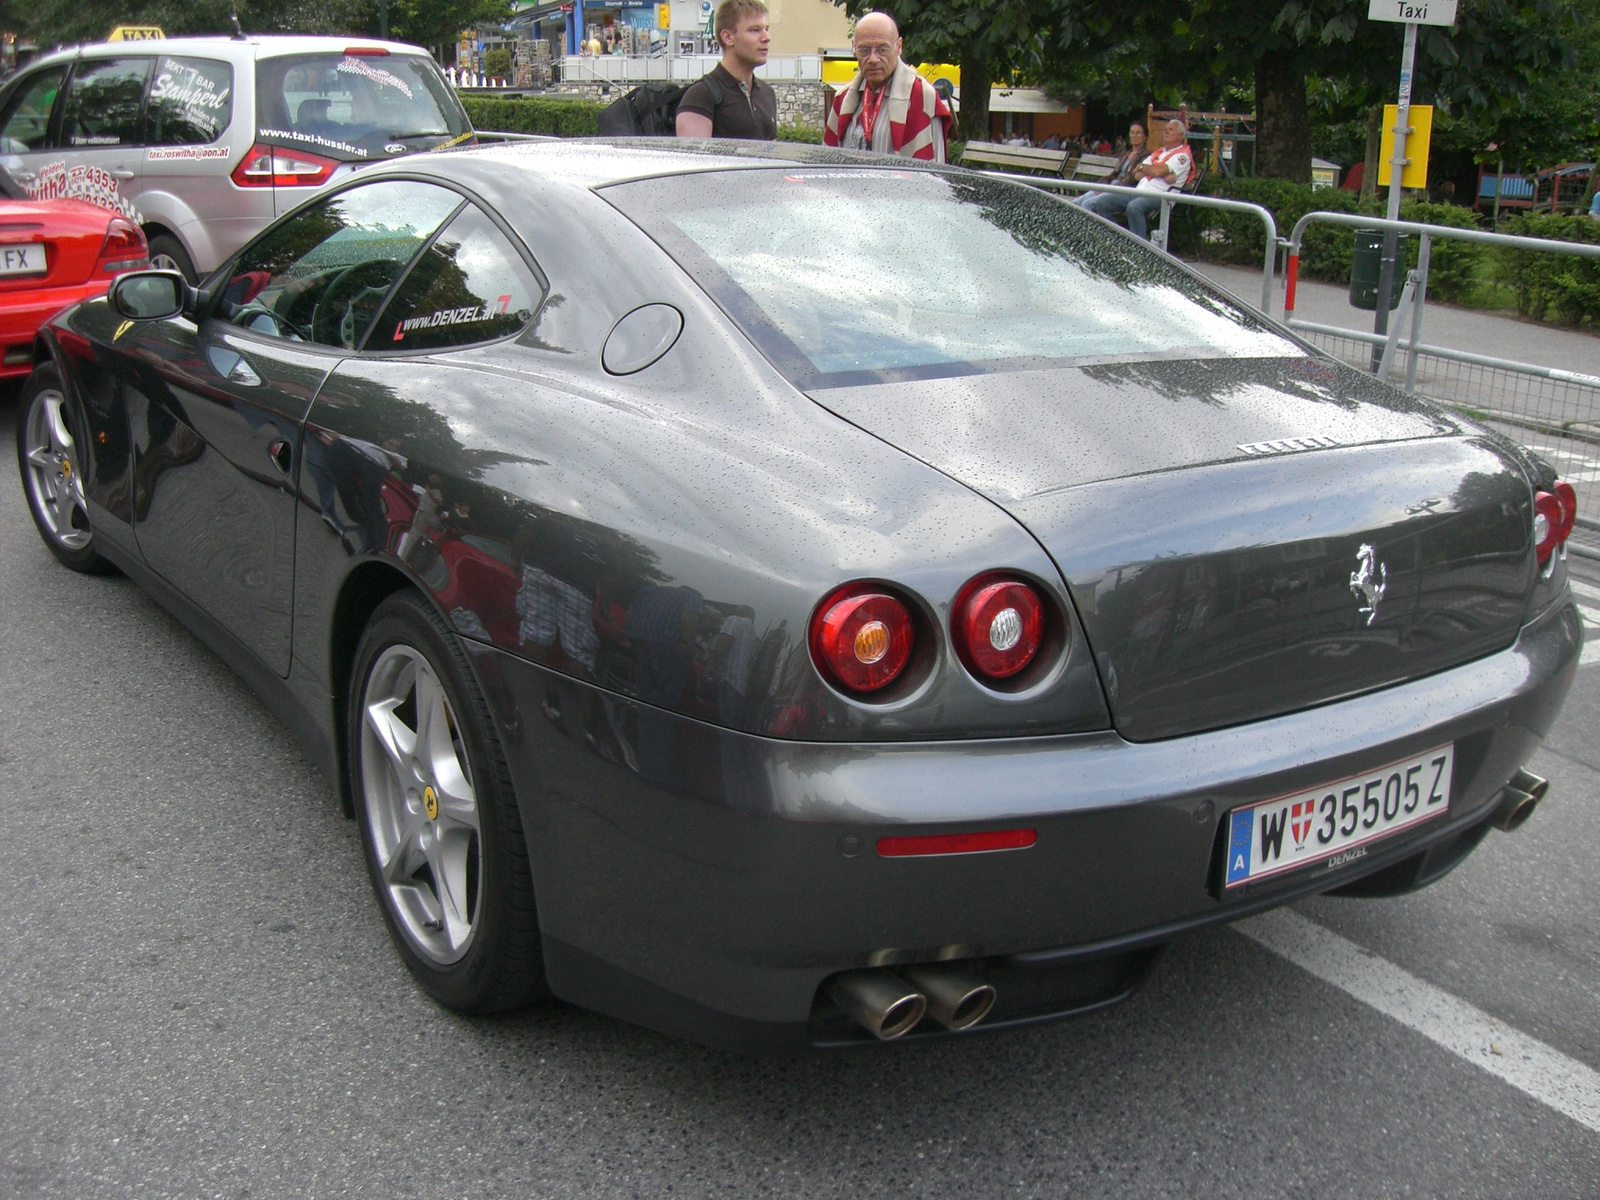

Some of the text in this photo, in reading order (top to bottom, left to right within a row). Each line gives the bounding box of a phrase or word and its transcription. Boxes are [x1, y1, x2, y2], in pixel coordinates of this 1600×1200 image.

[1397, 1, 1429, 19] Taxi
[124, 30, 160, 42] TAXI
[164, 59, 215, 92] SEKT BAR
[150, 74, 230, 111] Stamperl
[148, 147, 229, 159] taxi.roswitha@aon.at
[259, 129, 368, 157] www.taxi-hussler.at
[27, 172, 67, 201] witha
[86, 168, 117, 193] 4353
[4, 248, 28, 269] FX
[403, 306, 497, 332] www.DENZEL.at
[1261, 807, 1288, 864] W
[1233, 854, 1245, 871] A
[1328, 846, 1368, 868] DENZEL
